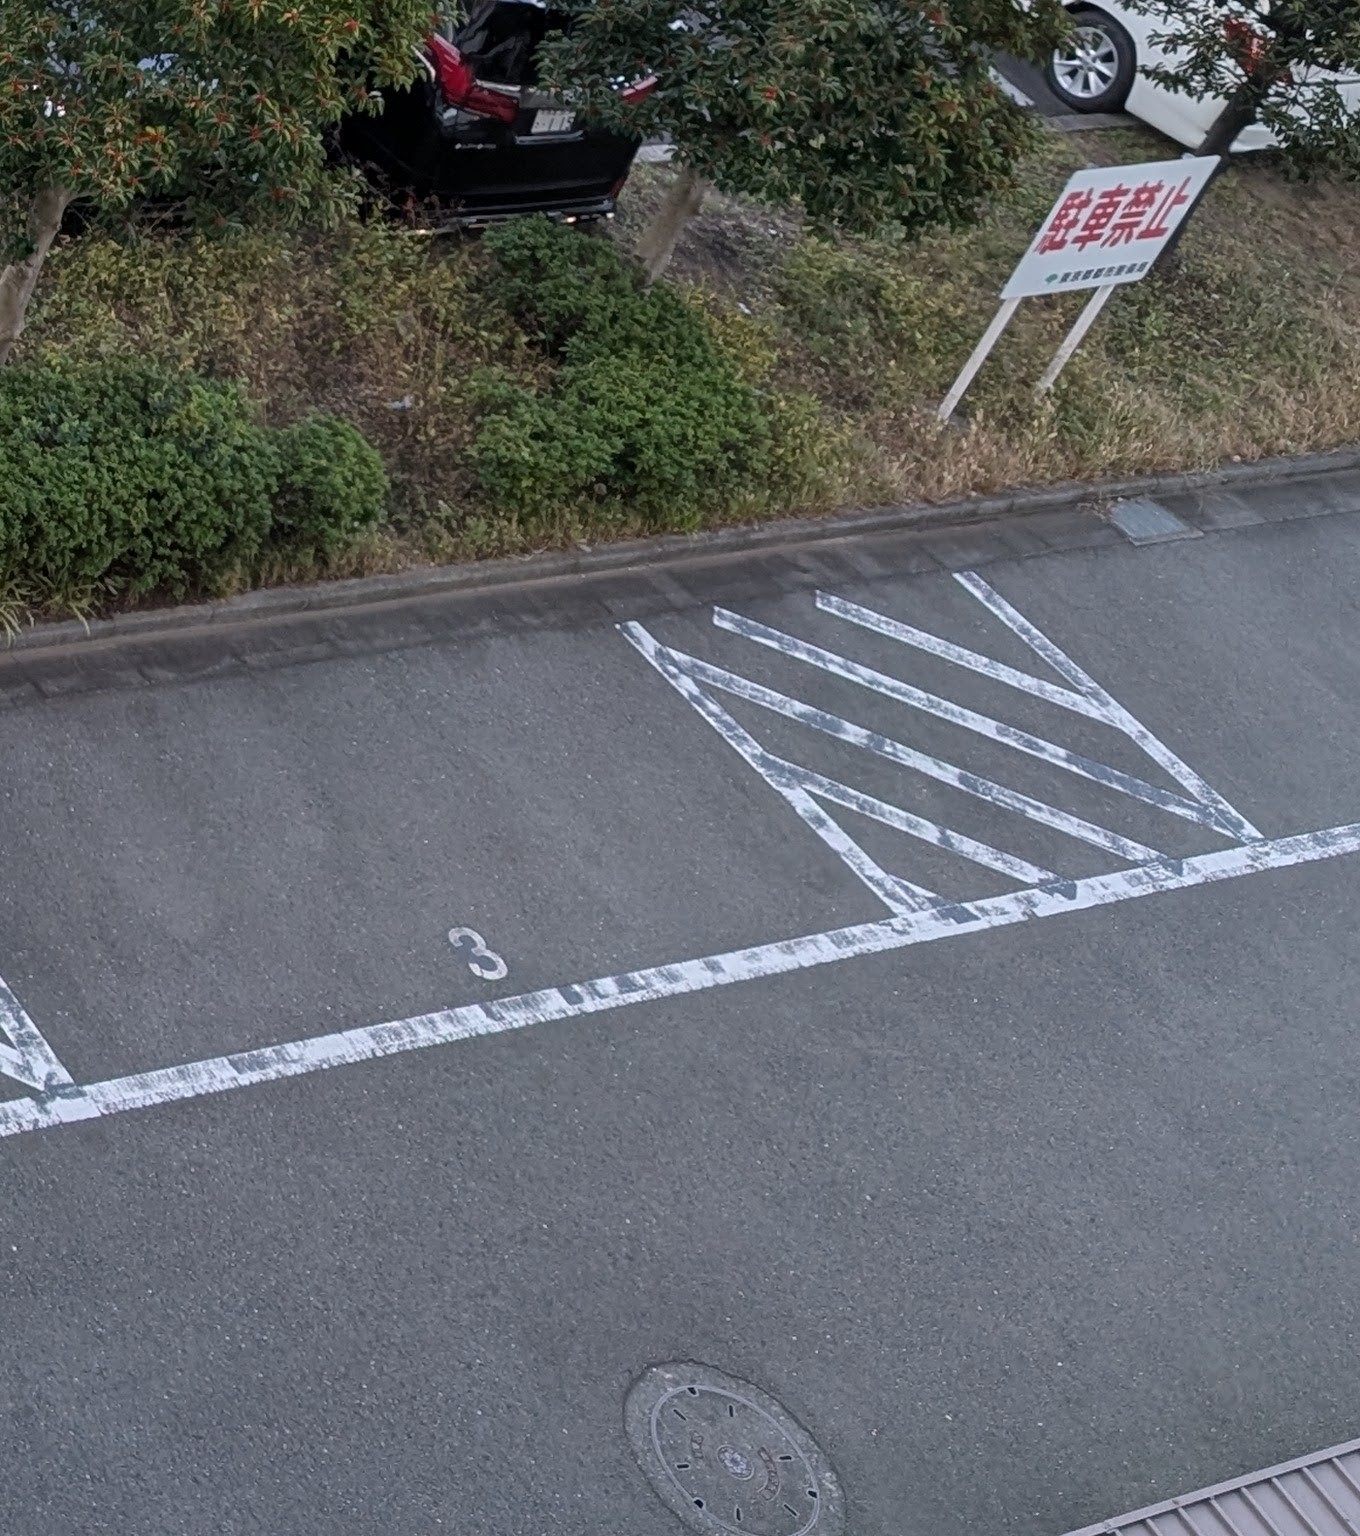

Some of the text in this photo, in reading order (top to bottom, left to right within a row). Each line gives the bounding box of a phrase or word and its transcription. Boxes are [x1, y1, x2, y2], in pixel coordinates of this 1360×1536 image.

[1033, 176, 1192, 255] 駐車禁止
[448, 926, 509, 980] 3
